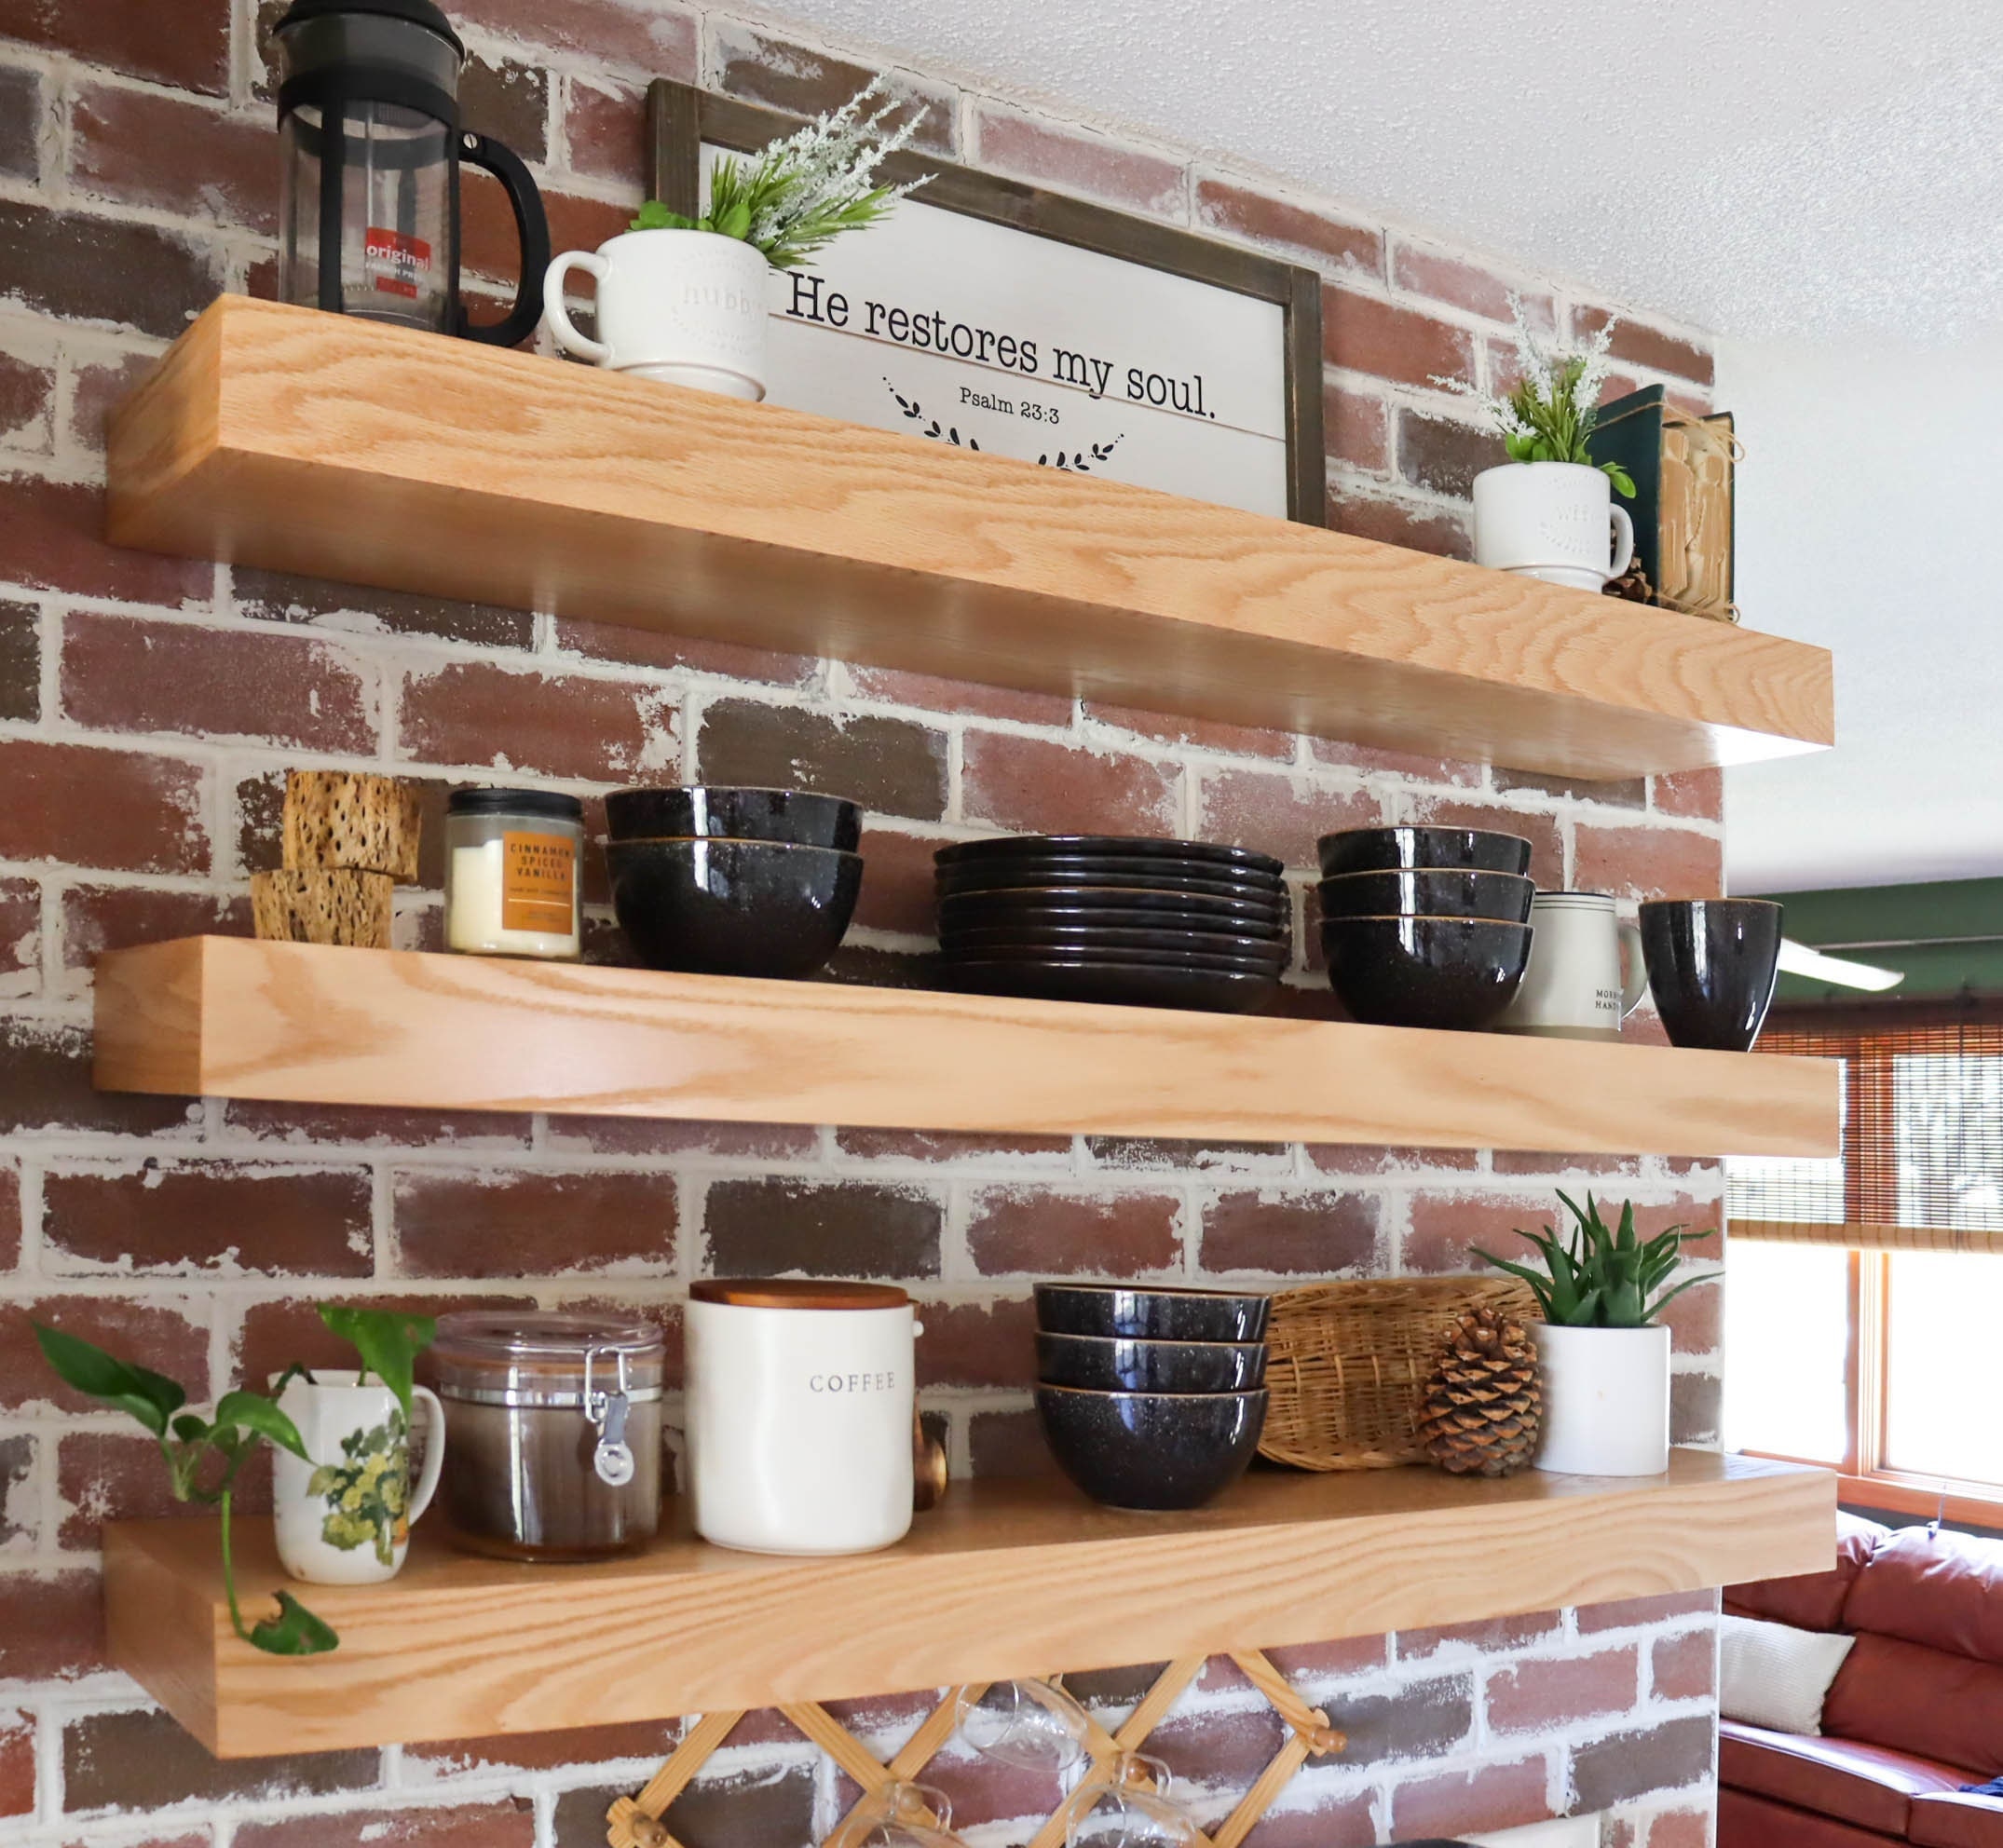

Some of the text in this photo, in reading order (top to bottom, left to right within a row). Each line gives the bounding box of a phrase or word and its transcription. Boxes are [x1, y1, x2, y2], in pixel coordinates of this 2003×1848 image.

[365, 244, 430, 271] original
[785, 270, 1215, 419] He restores my soul.
[959, 386, 1060, 425] Psalm 23:3
[521, 855, 564, 868] SPICE
[809, 1371, 895, 1393] COFFEE
